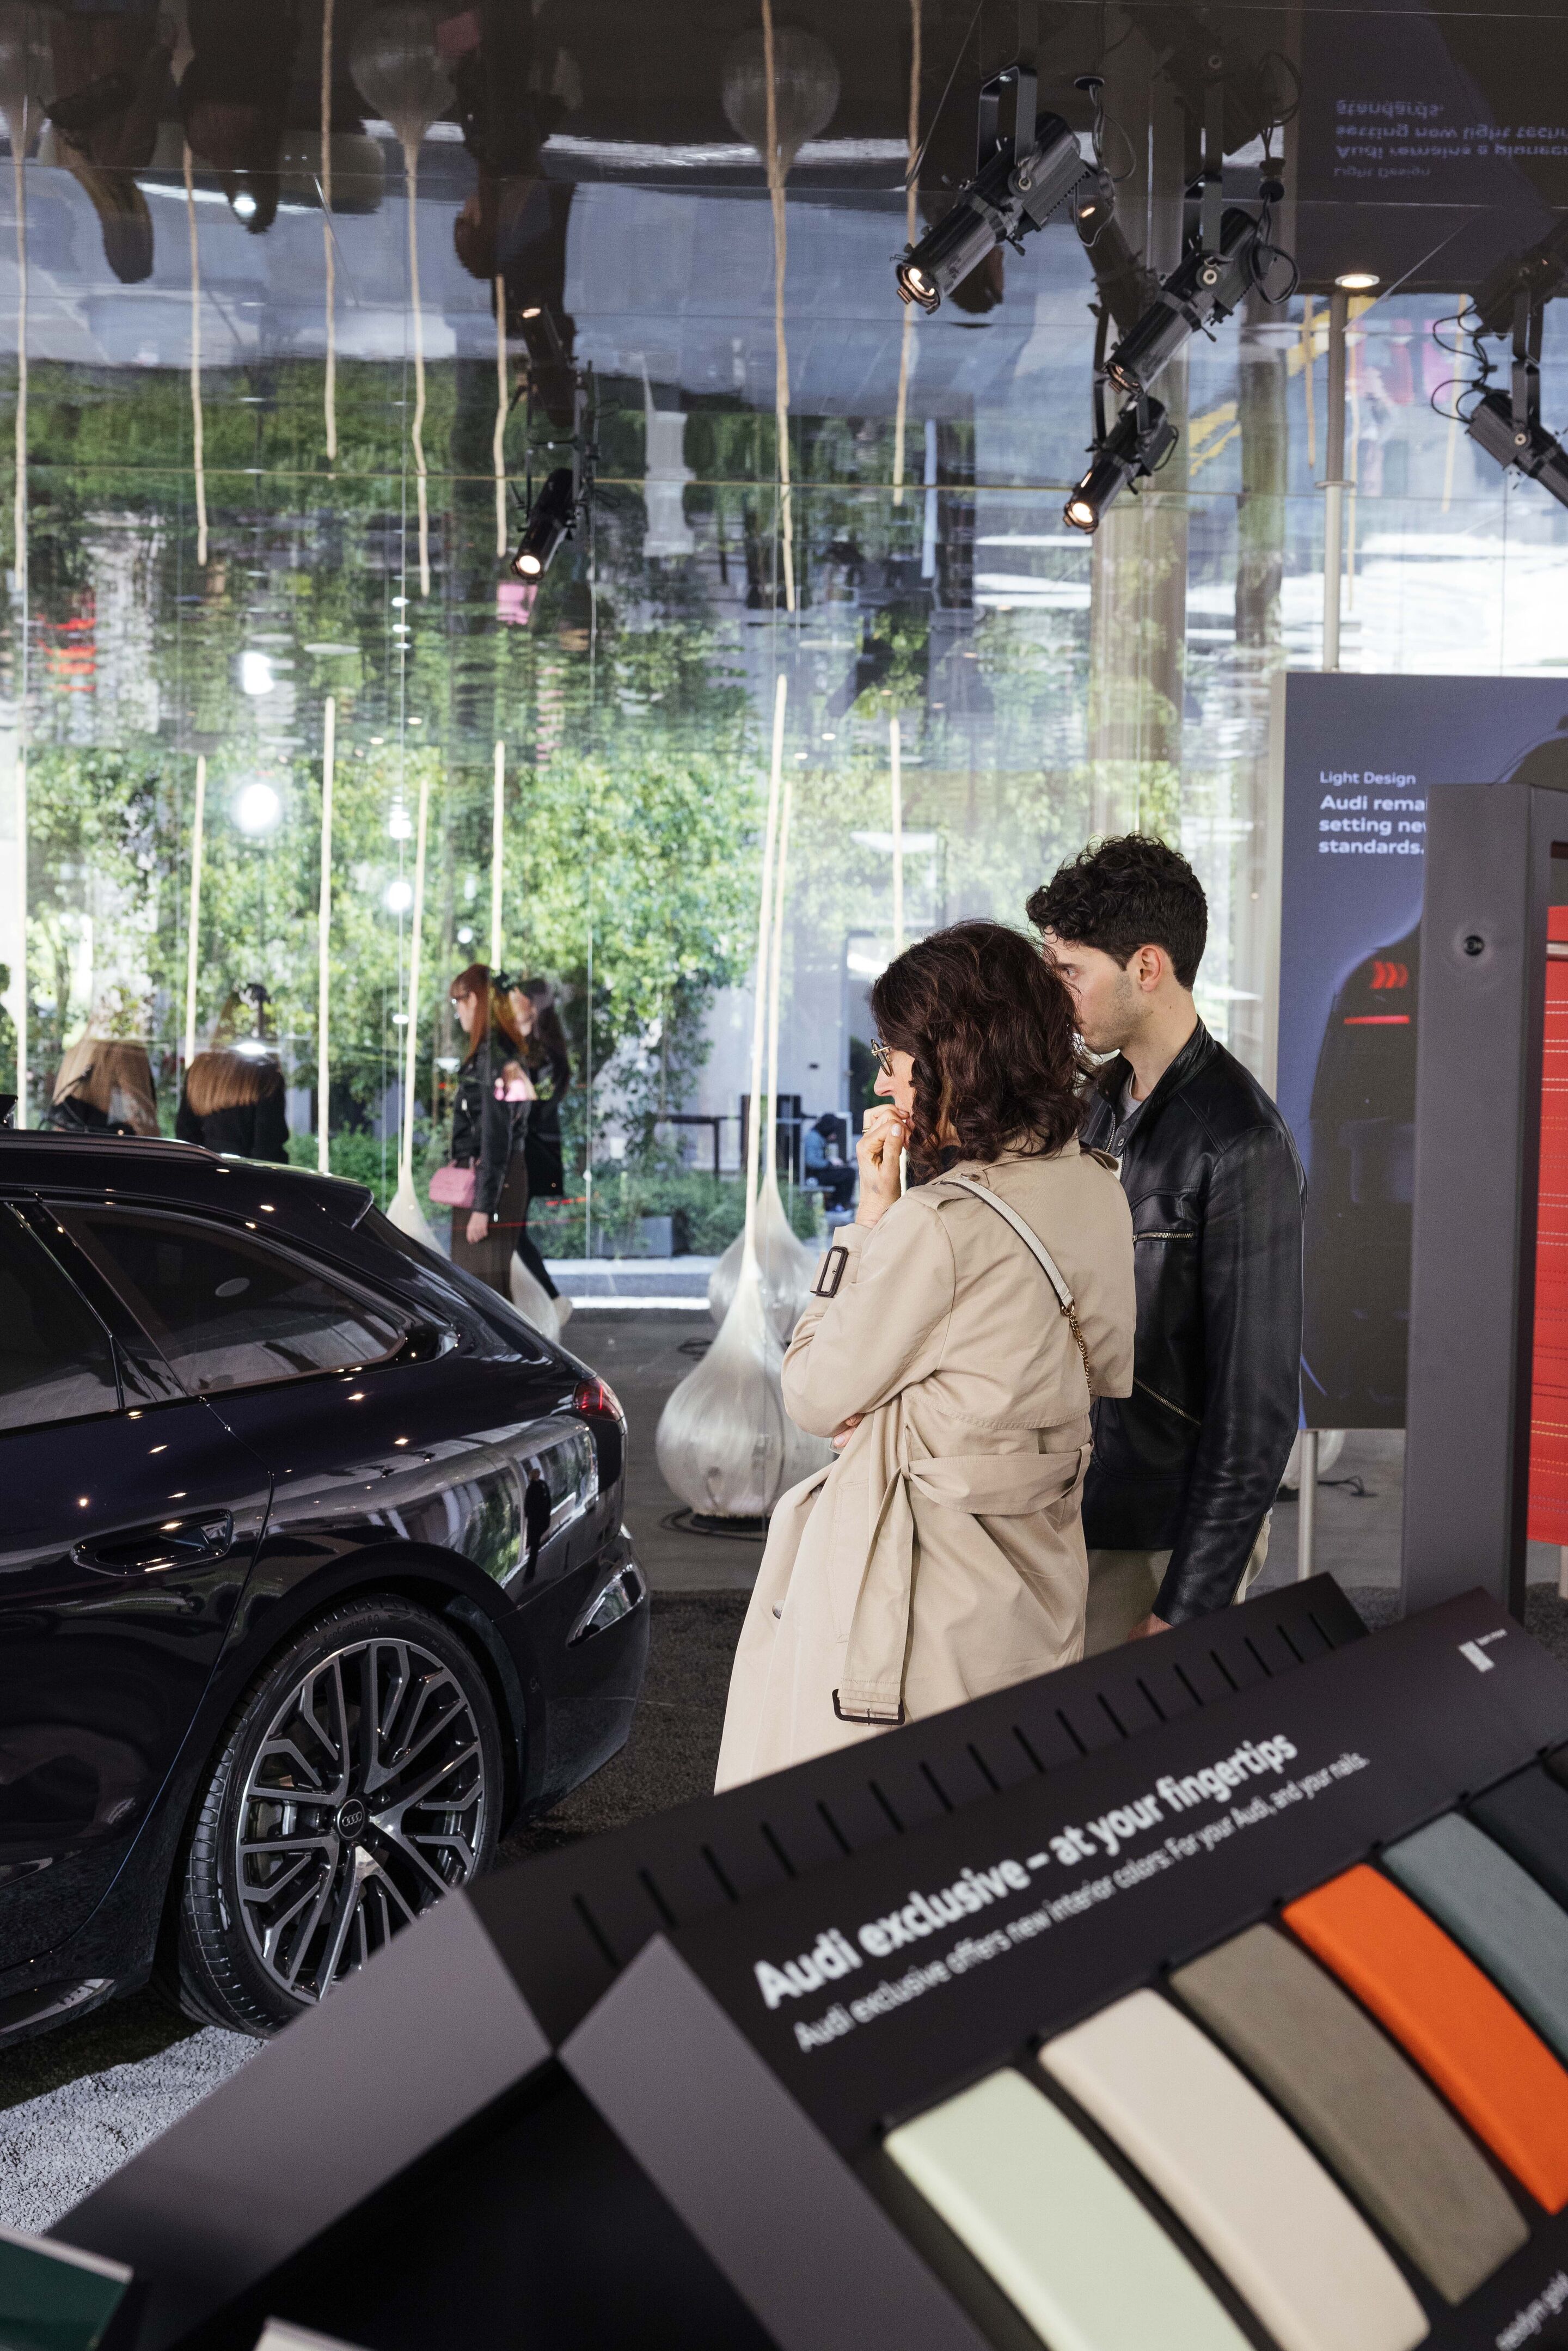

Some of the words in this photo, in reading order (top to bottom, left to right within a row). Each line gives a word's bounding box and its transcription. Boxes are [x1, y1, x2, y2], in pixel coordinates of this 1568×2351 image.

[1320, 771, 1360, 786] Light
[1363, 772, 1416, 787] Design
[1320, 794, 1368, 810] Audi
[1373, 796, 1428, 811] rema
[1319, 817, 1392, 836] setting
[1318, 839, 1425, 855] standards.
[754, 1927, 863, 2009] Audi
[857, 1858, 1031, 1957] exclusive
[1049, 1825, 1098, 1866] at
[1085, 1793, 1165, 1857] your
[1155, 1734, 1298, 1813] fingertips
[793, 2001, 857, 2054] Audi
[848, 1958, 952, 2023] exclusive
[946, 1929, 1012, 1975] offers
[1006, 1908, 1052, 1944] new
[1042, 1875, 1117, 1923] interior
[1197, 1815, 1237, 1852] your
[1229, 1796, 1278, 1829] Audi,
[1269, 1779, 1304, 1809] and
[1295, 1767, 1333, 1800] your
[1328, 1752, 1370, 1779] nails.
